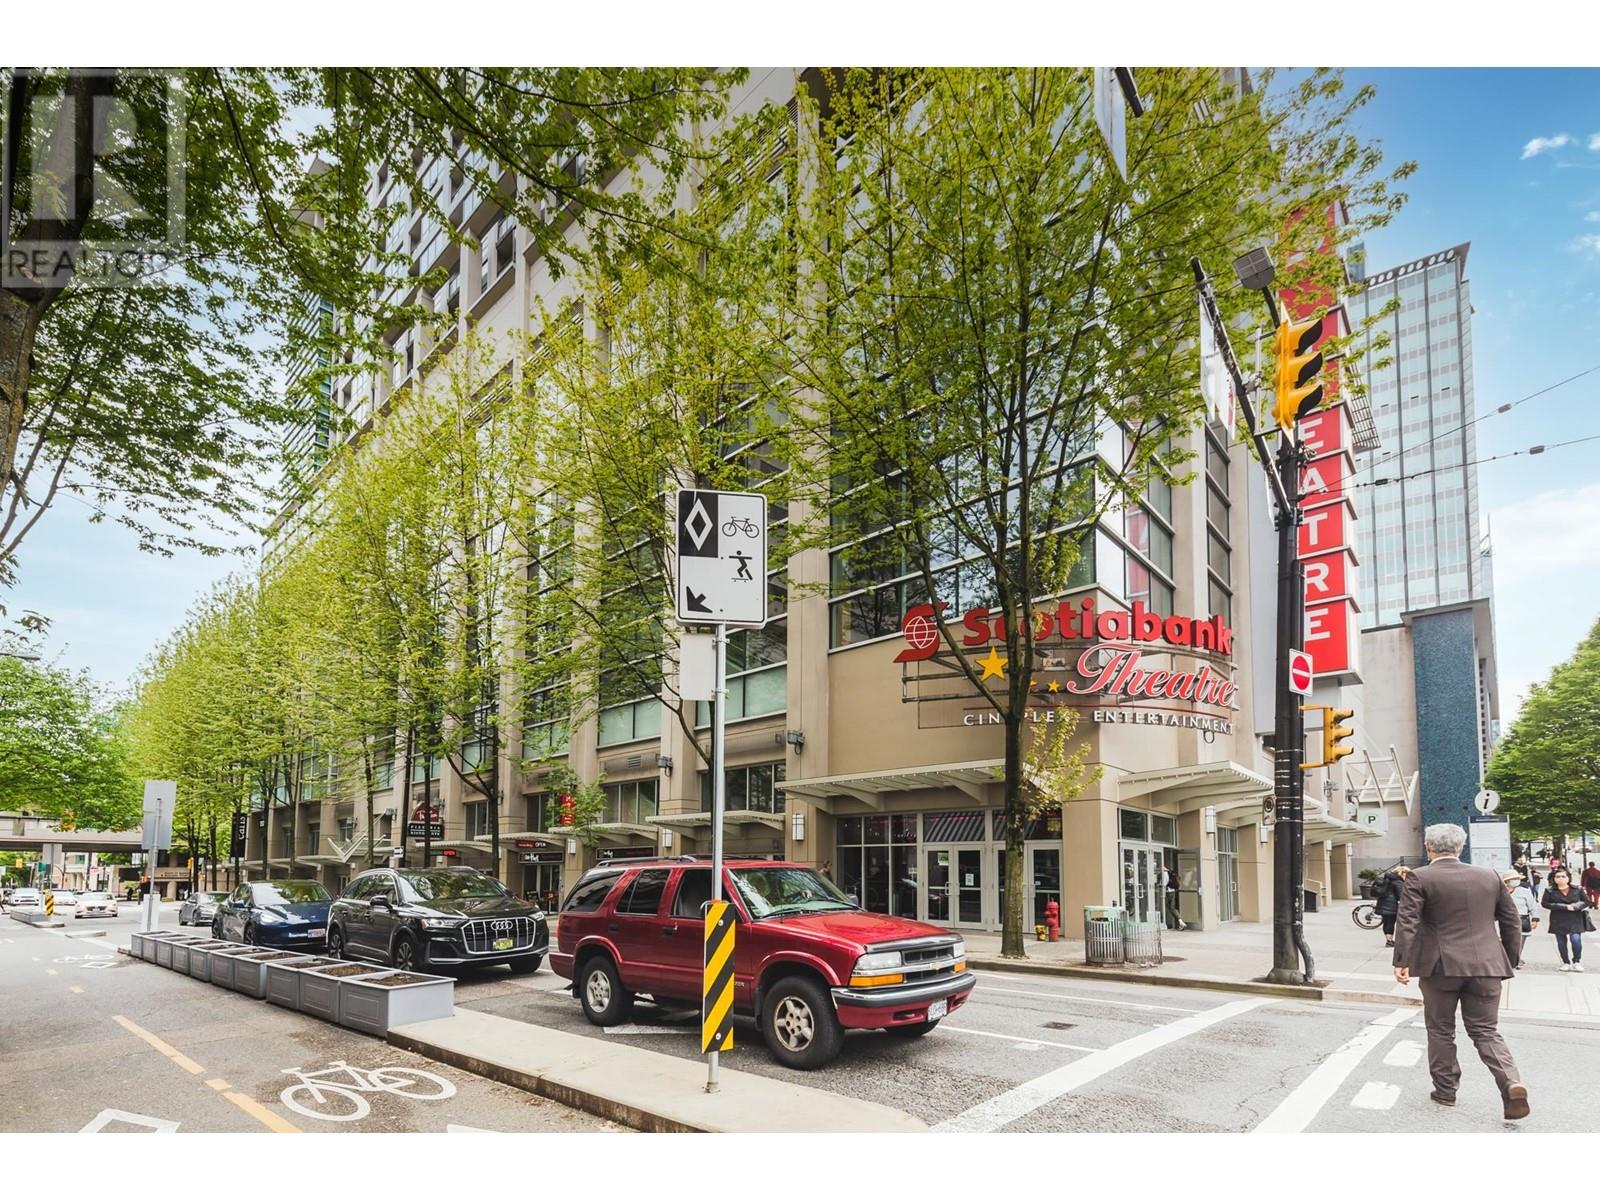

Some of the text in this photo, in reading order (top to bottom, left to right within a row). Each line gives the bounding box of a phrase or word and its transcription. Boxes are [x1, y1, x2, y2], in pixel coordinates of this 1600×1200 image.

[1297, 417, 1331, 642] EATRE
[963, 598, 1232, 656] Scotiabank
[1066, 643, 1236, 706] Theatre
[963, 710, 1234, 735] CINLE ENTERTAINMENT
[1368, 815, 1376, 824] P
